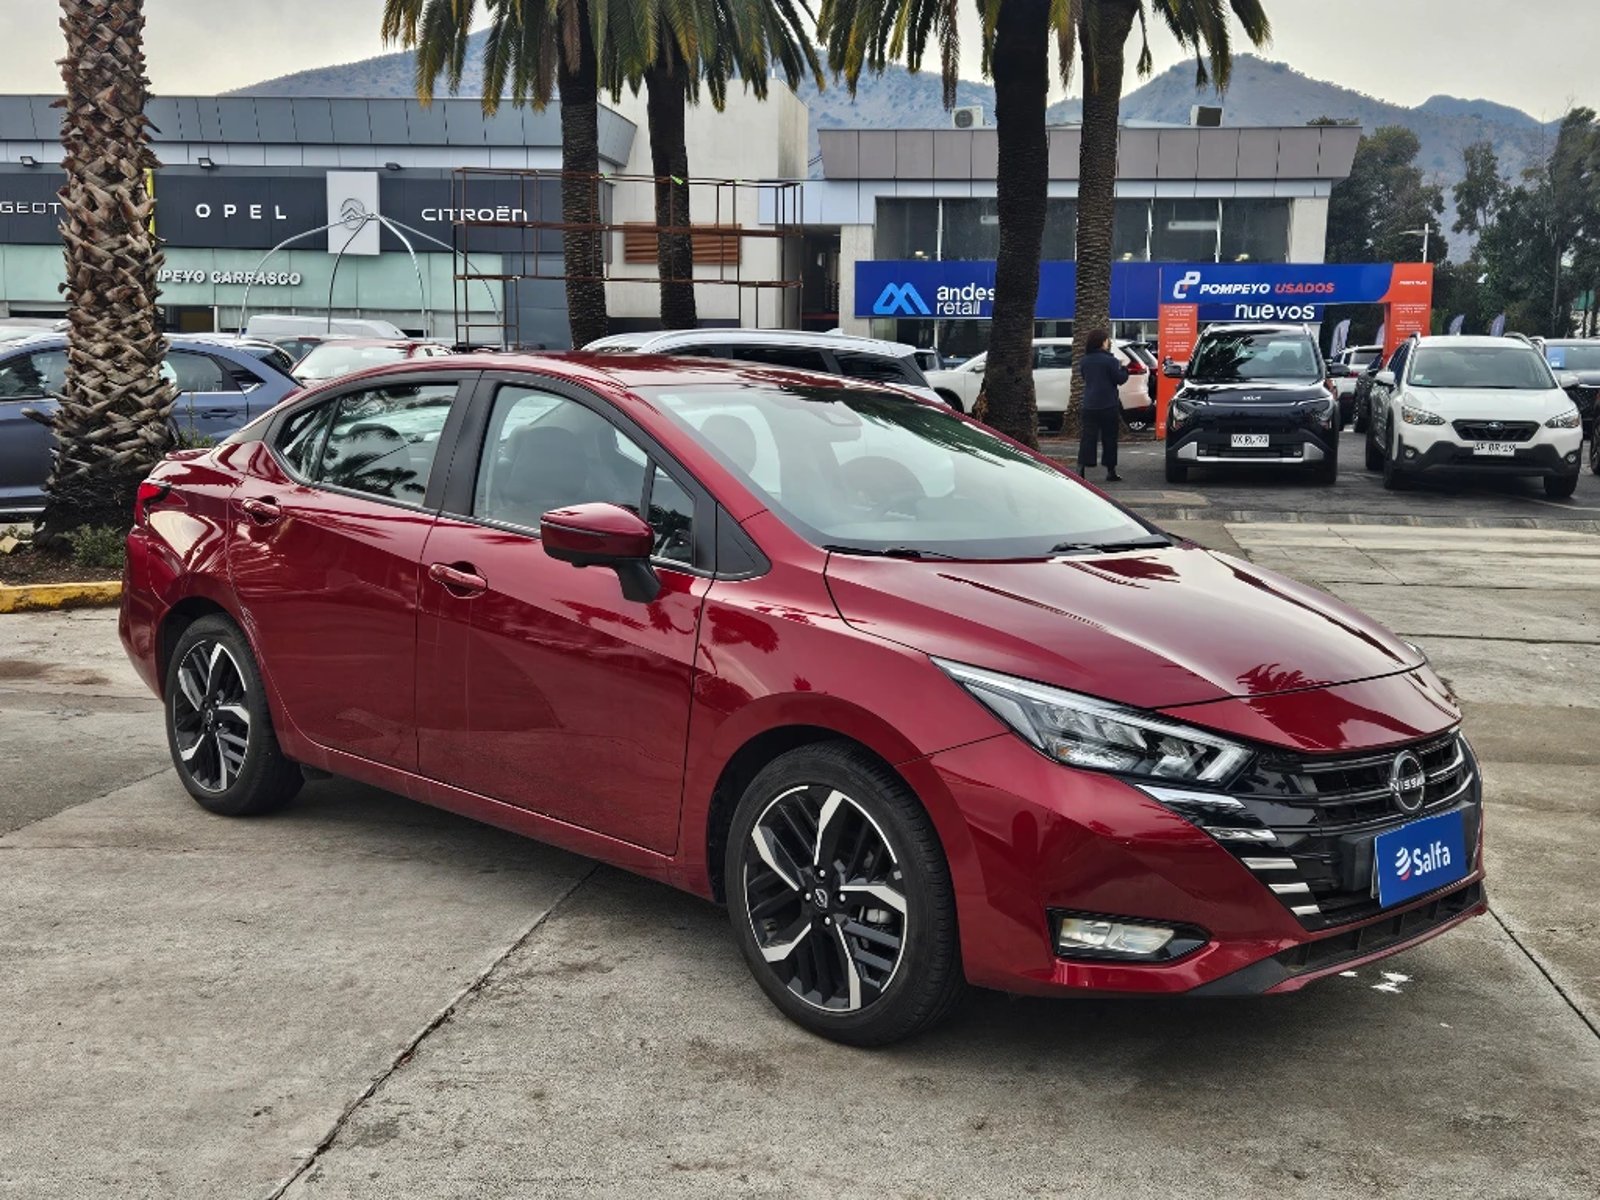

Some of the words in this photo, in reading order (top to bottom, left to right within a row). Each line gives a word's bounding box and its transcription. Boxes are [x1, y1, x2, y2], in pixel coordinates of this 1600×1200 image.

[0, 201, 62, 215] GEOT
[195, 203, 287, 220] OPEL
[156, 270, 206, 284] PEYO
[210, 271, 302, 286] CARRASCO
[936, 282, 996, 301] andes
[1199, 283, 1271, 295] POMPEYO
[1274, 282, 1336, 294] USADOS
[936, 300, 981, 315] retail
[1234, 303, 1315, 320] nuevos
[1412, 841, 1451, 876] Salfa
